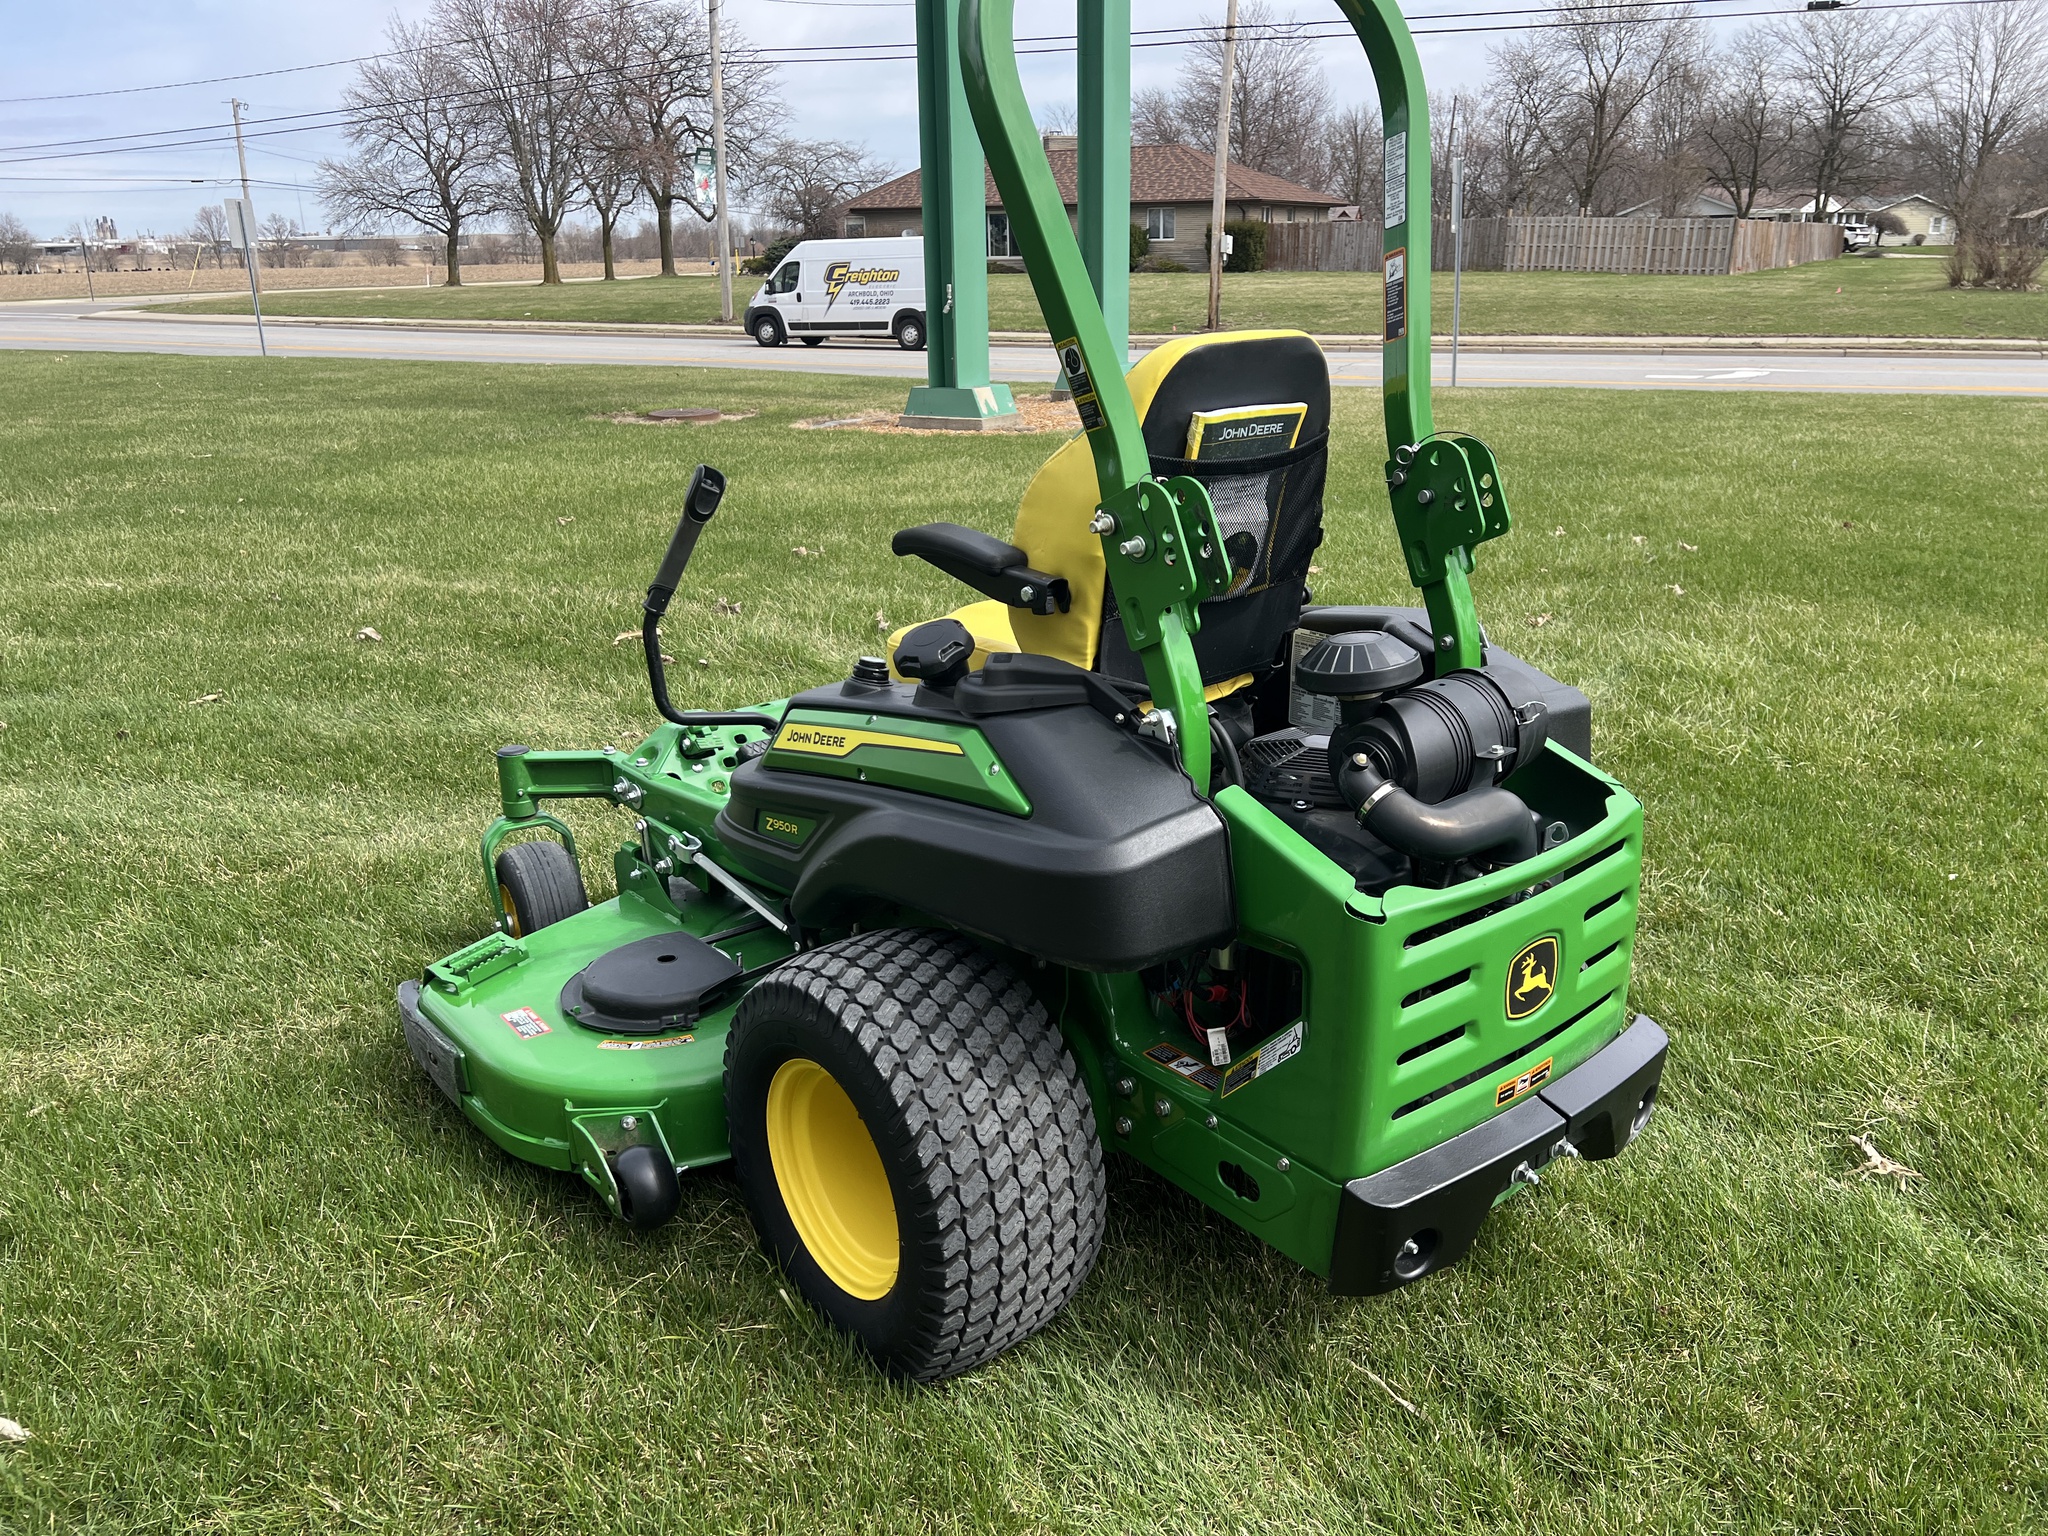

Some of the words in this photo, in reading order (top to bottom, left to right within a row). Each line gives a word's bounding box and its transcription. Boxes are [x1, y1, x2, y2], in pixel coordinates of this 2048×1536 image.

[824, 261, 900, 285] Creighton
[848, 290, 879, 298] ARCHBOLD,
[1218, 427, 1248, 441] JOHN
[1248, 423, 1284, 436] DEERE
[787, 729, 812, 744] JOHN
[813, 731, 846, 748] DEERE
[766, 817, 798, 835] Z950R
